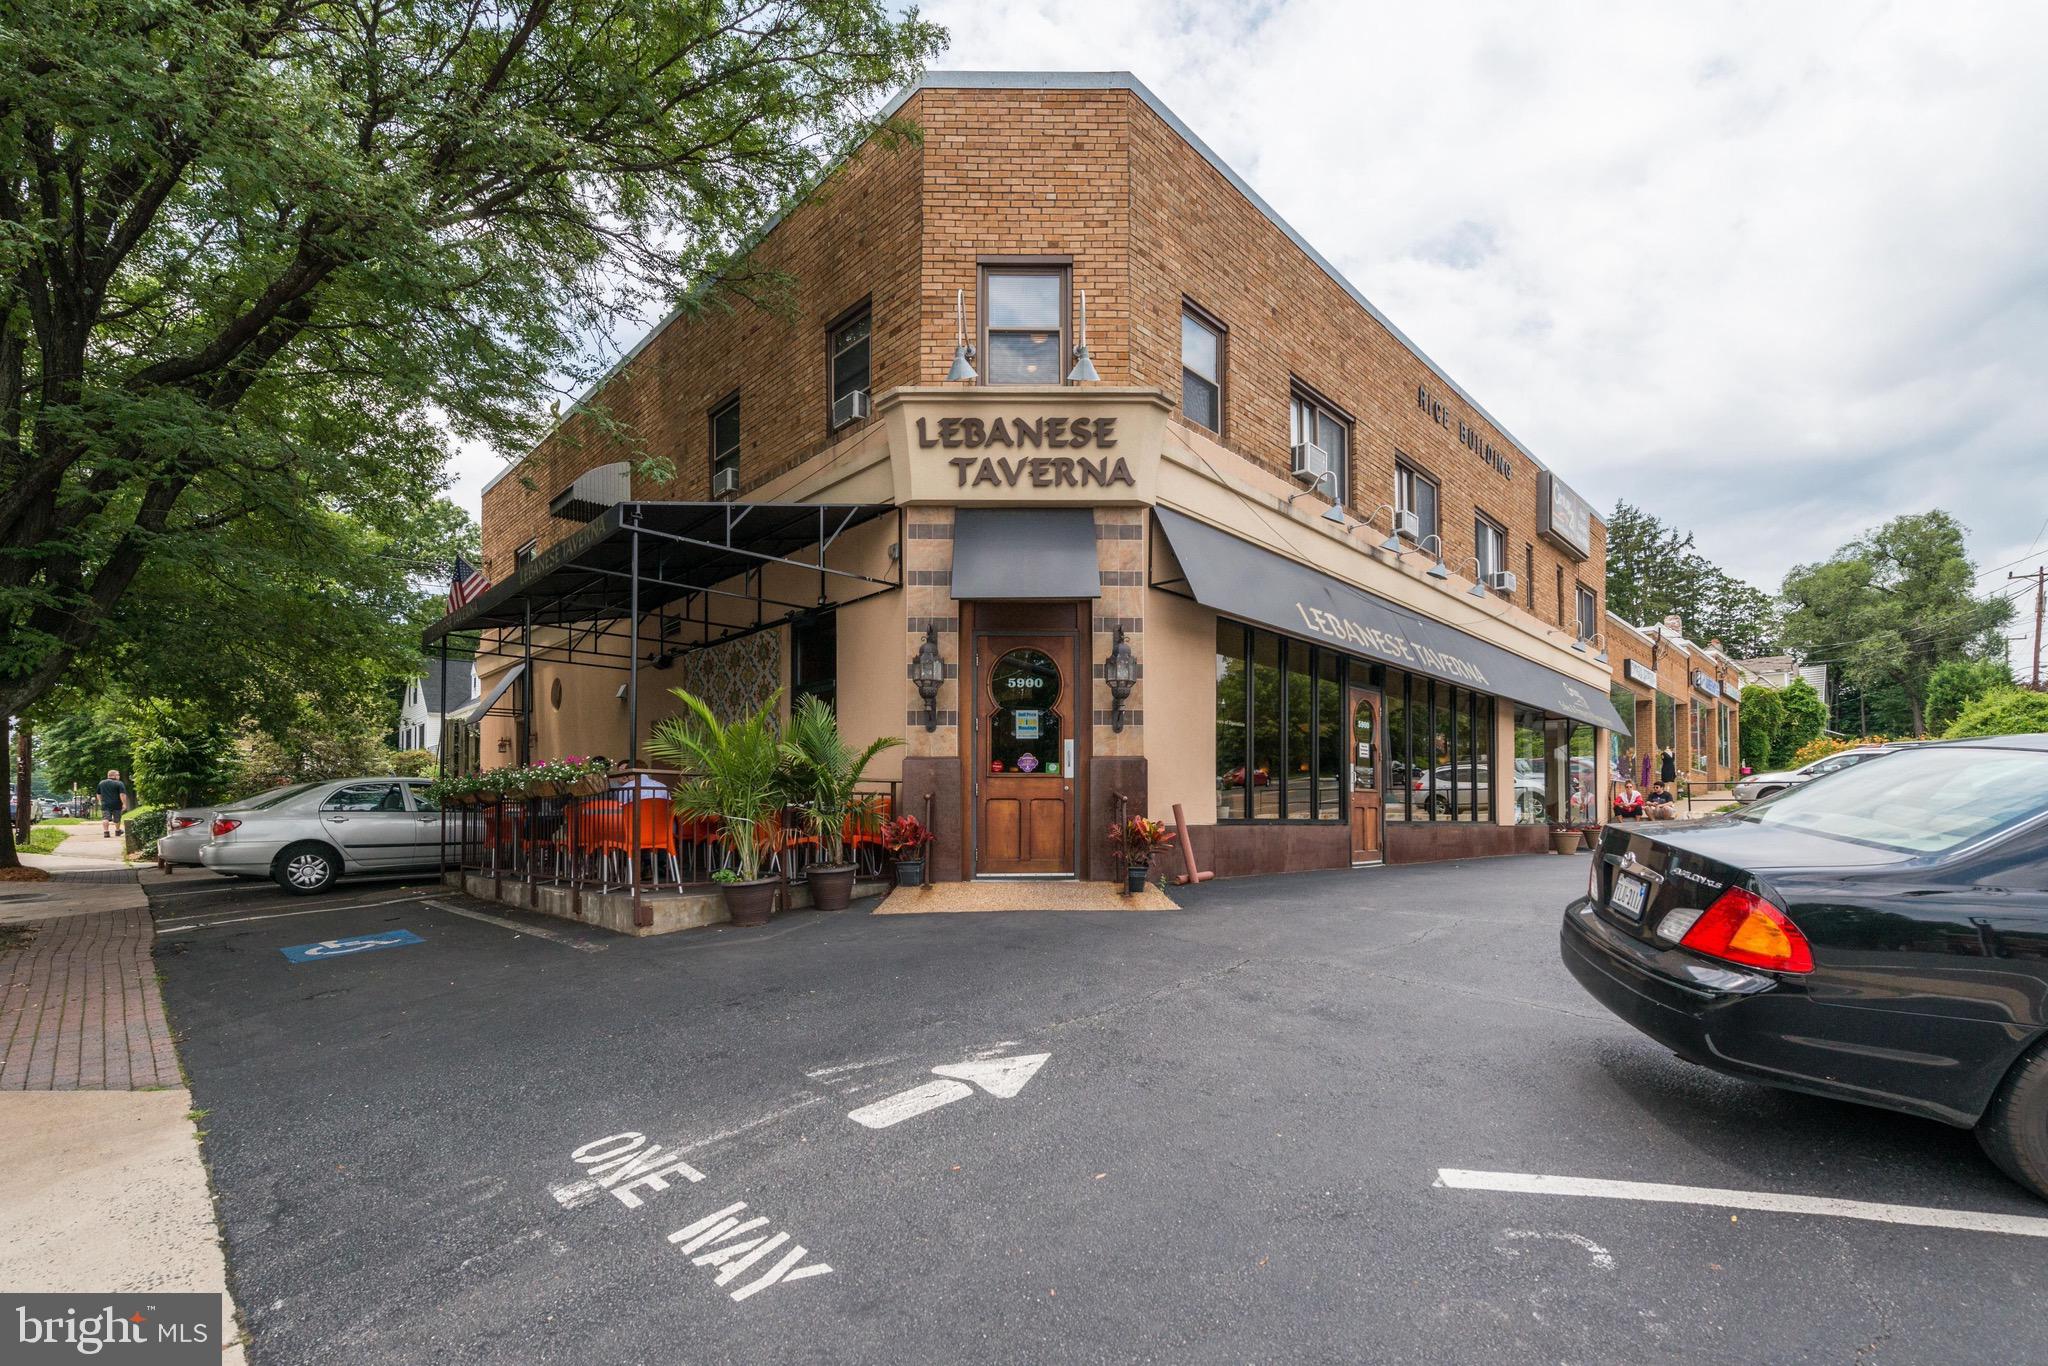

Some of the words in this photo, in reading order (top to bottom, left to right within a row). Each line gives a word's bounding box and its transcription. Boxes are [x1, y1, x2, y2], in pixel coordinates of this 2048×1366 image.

[915, 416, 1119, 449] LEBANESE
[1418, 383, 1450, 430] RICE
[1459, 421, 1513, 480] BUILDING
[948, 456, 1136, 488] TAVERNA
[1008, 678, 1044, 688] 5900
[1295, 602, 1414, 662] LEBANESE
[1411, 642, 1490, 686] TAVERNA
[570, 1131, 706, 1210] ONE
[667, 1201, 834, 1301] WAY
